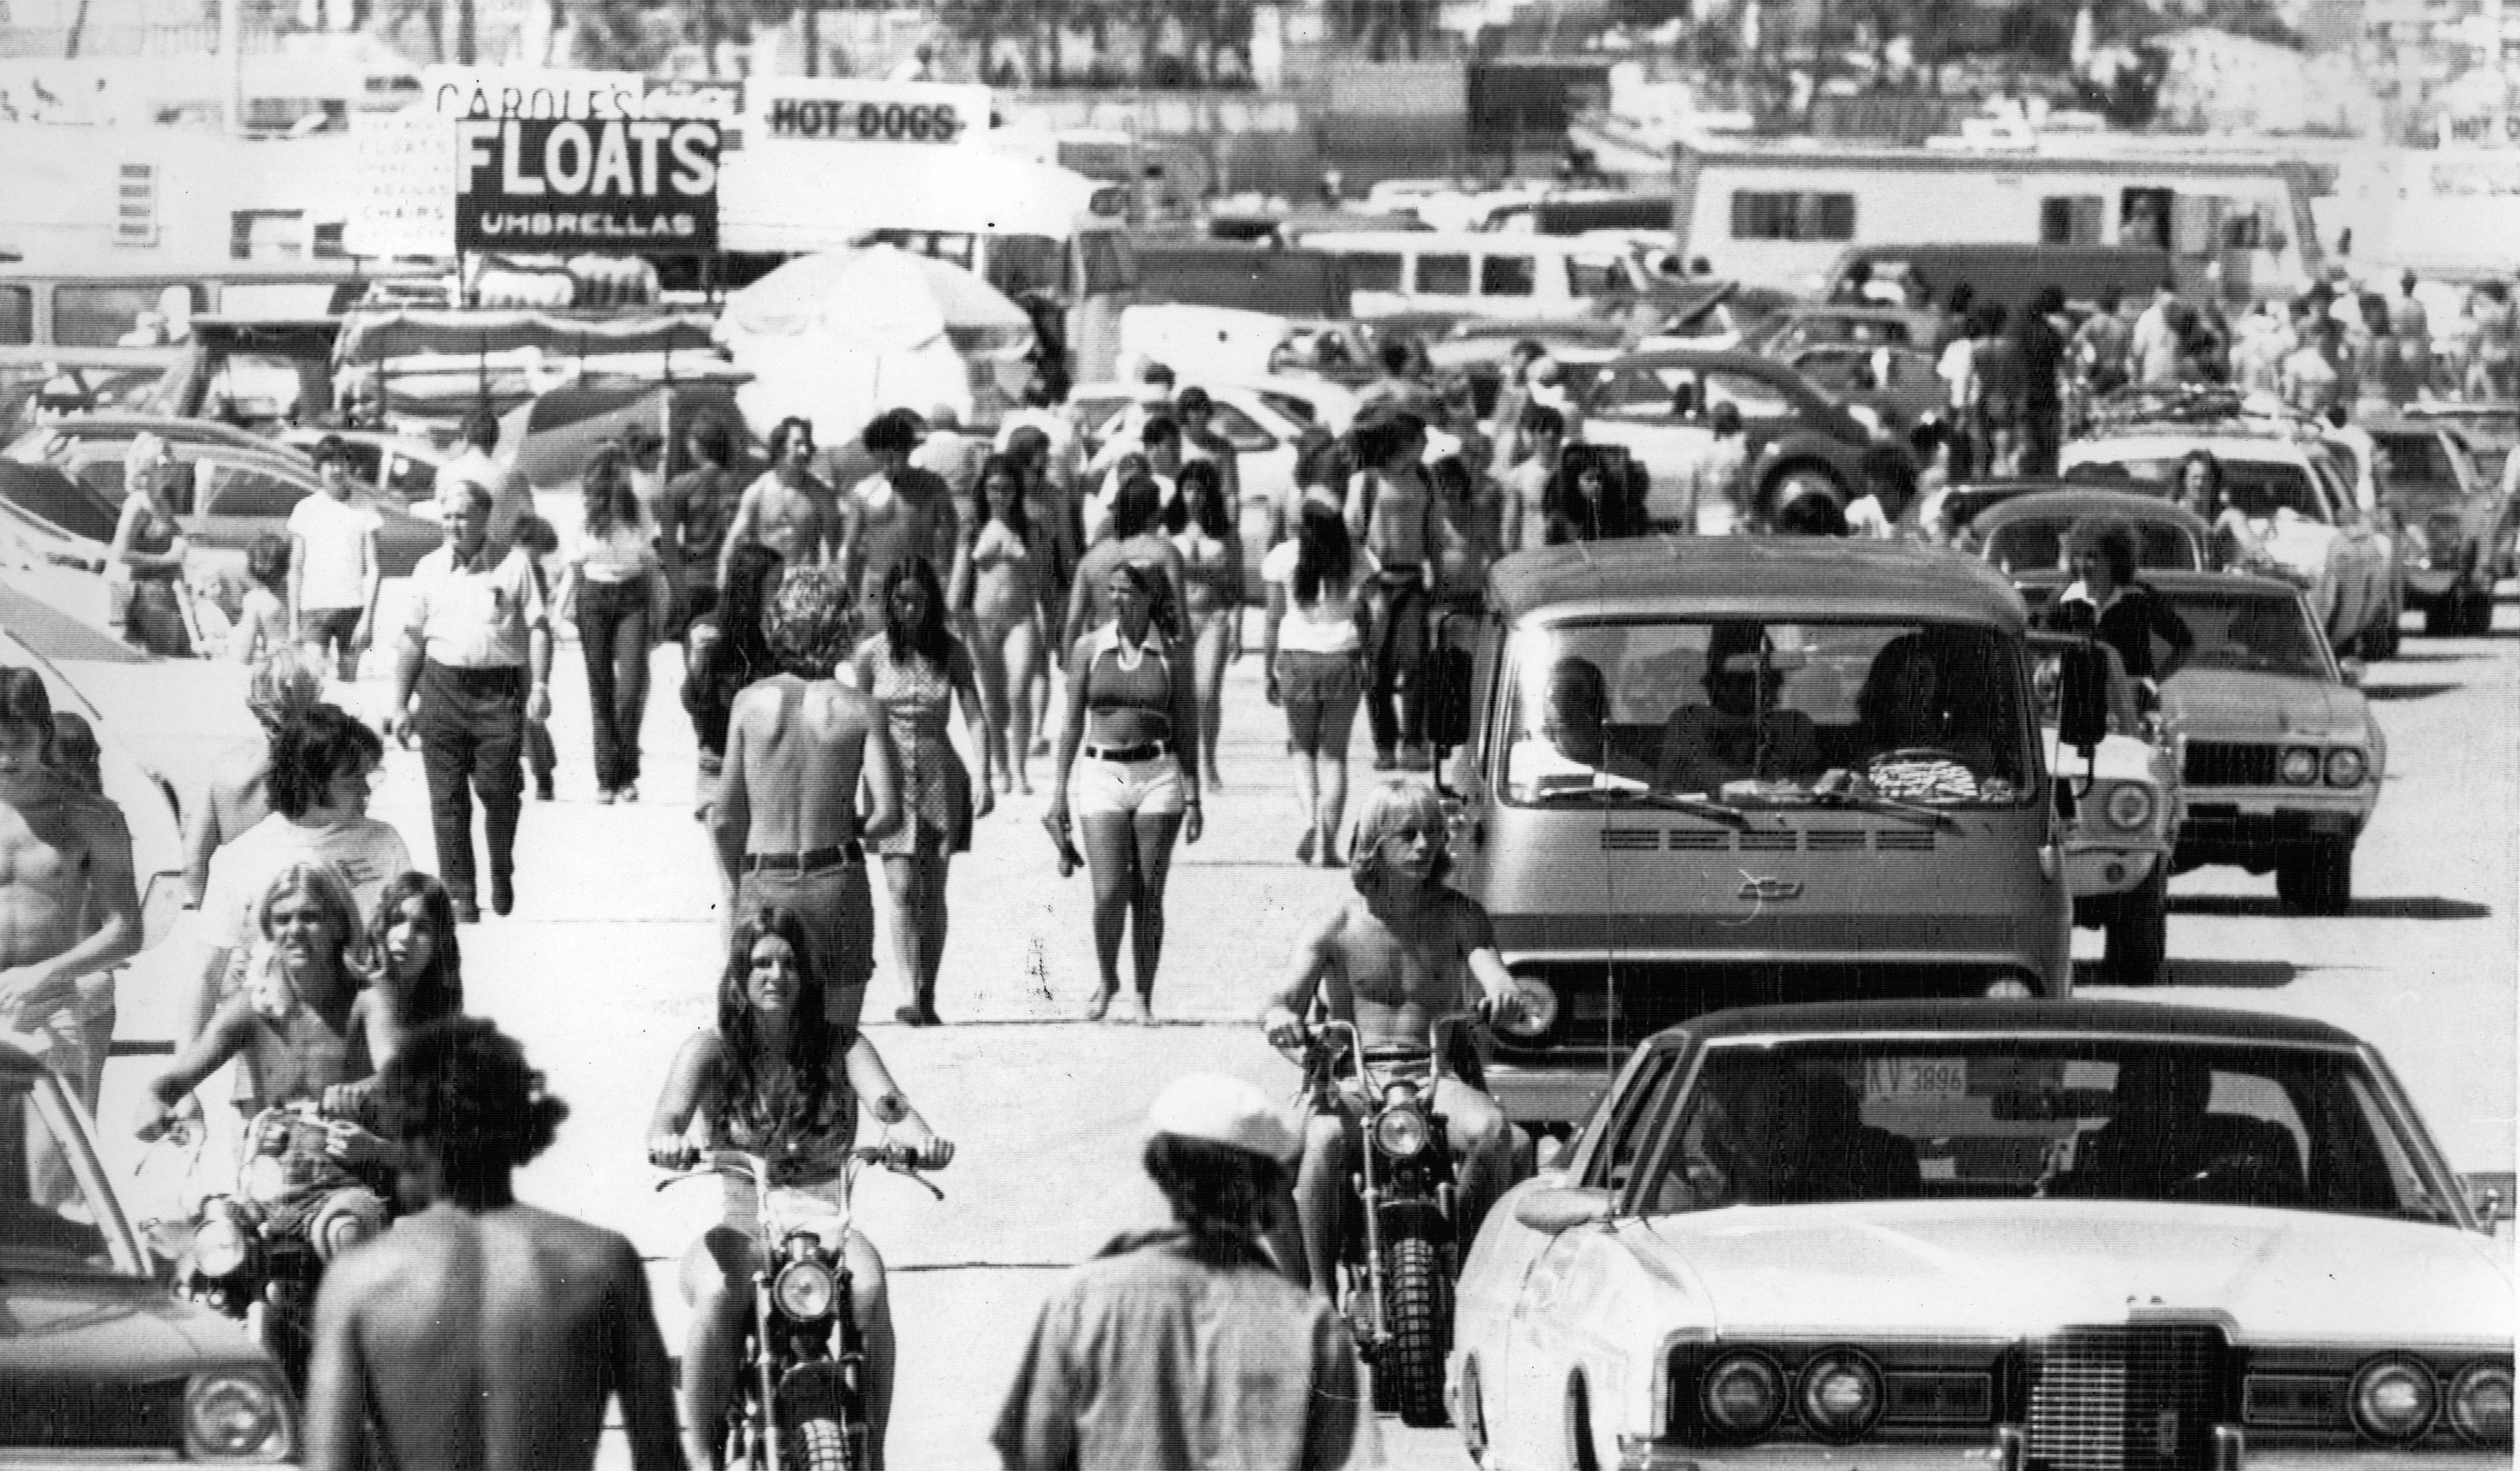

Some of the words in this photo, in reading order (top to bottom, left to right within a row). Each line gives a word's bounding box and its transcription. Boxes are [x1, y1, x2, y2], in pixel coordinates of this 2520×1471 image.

[773, 99, 844, 137] HOT
[858, 102, 957, 142] DOGS
[456, 120, 718, 196] FLOATS
[481, 212, 696, 235] UMBRELLAS
[1909, 1064, 1962, 1092] 3896
